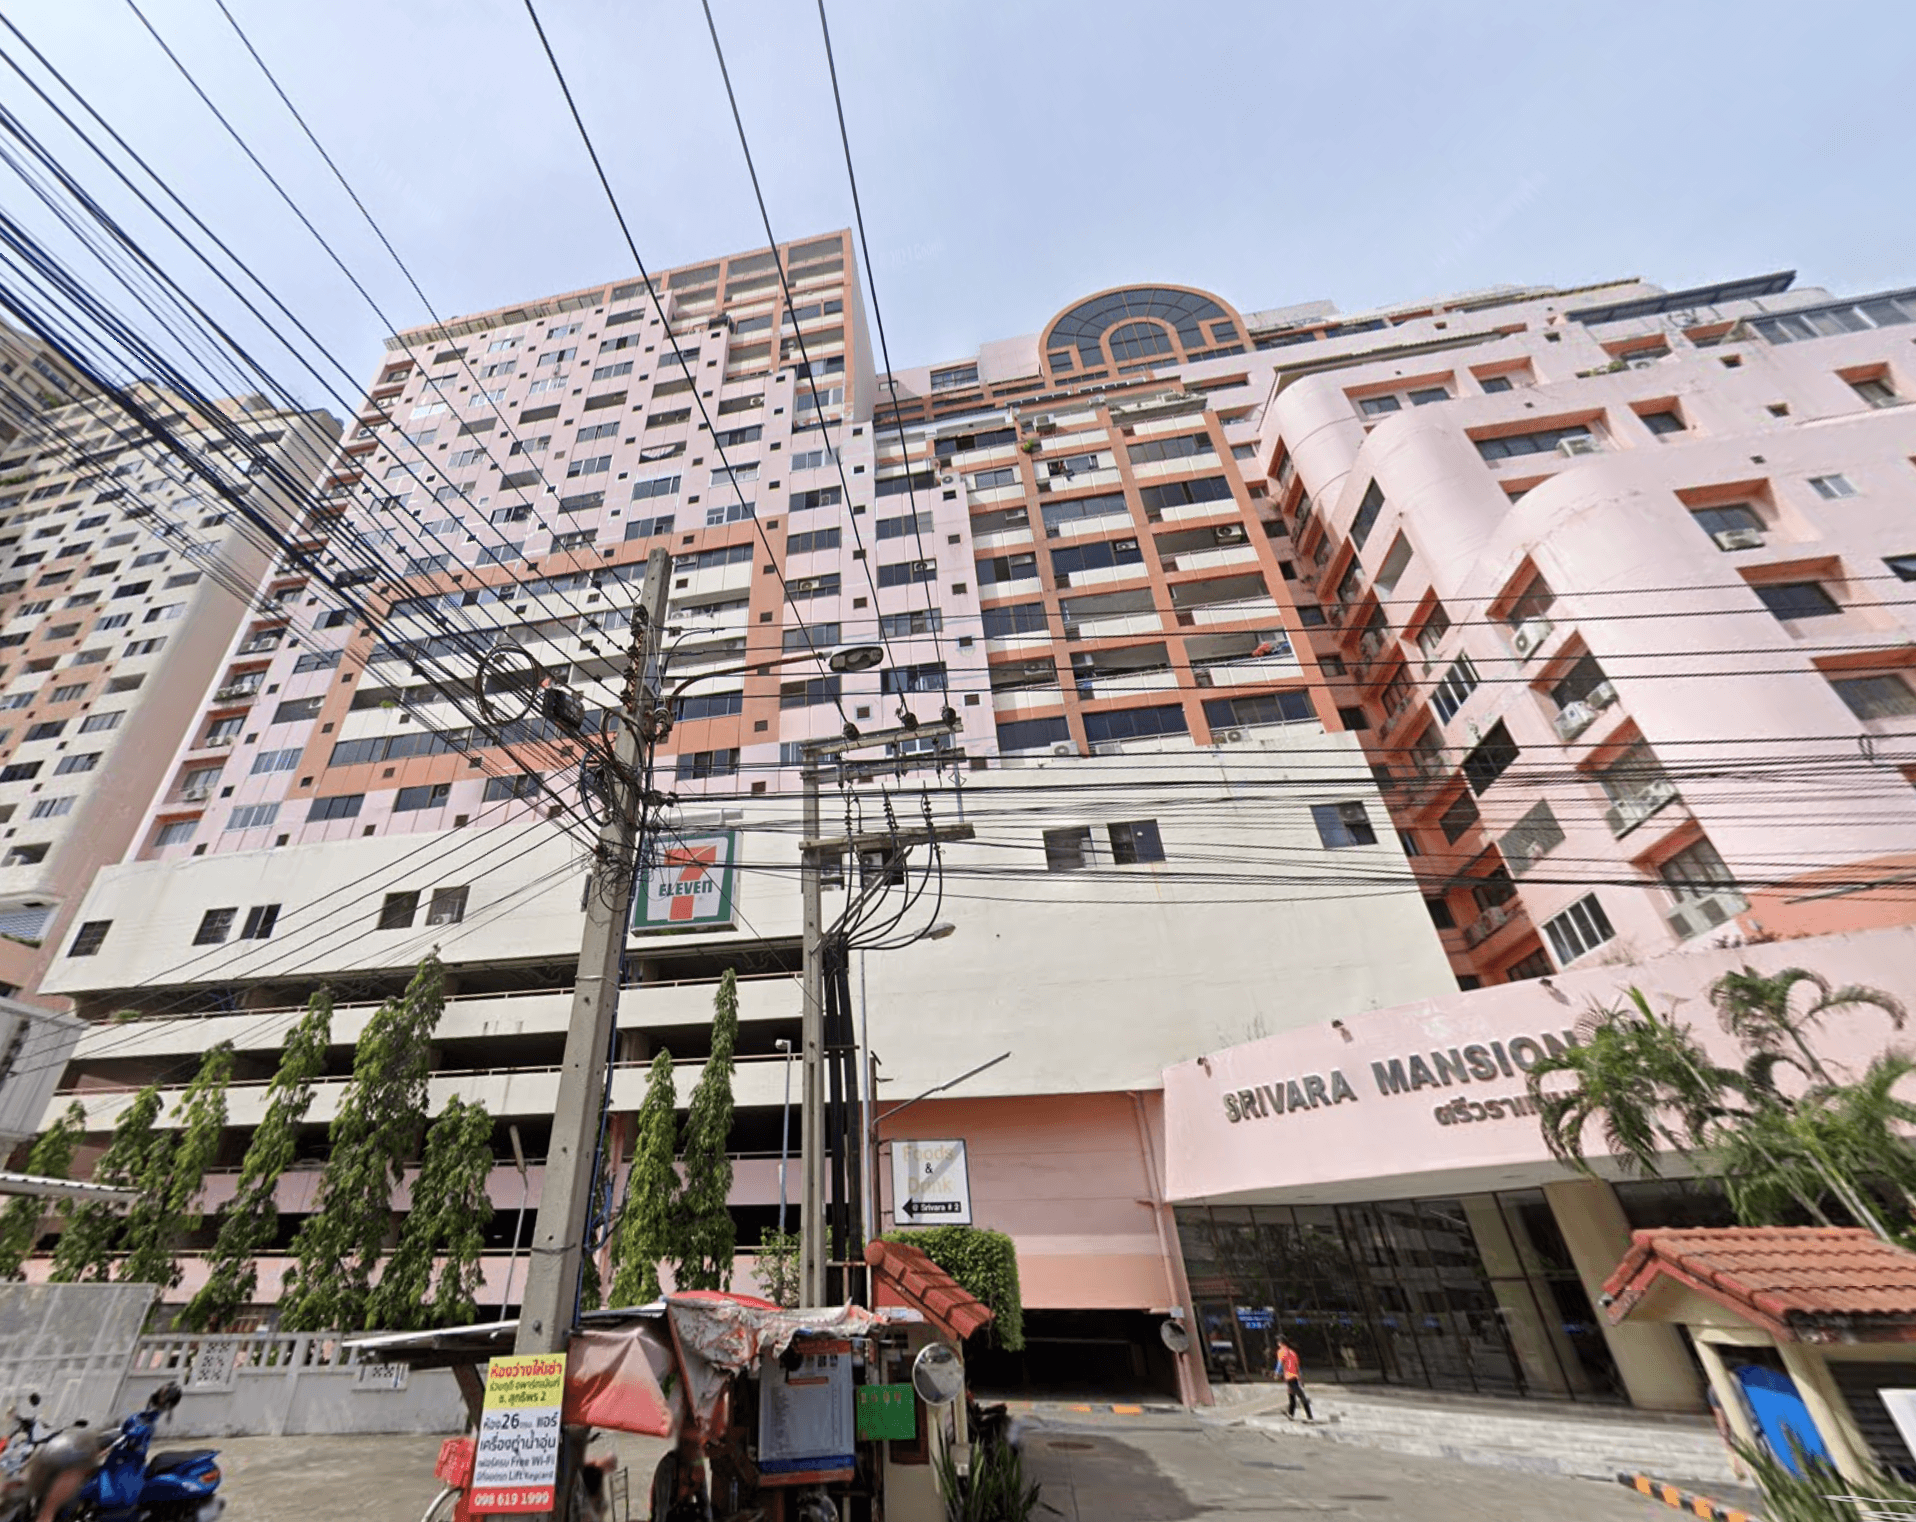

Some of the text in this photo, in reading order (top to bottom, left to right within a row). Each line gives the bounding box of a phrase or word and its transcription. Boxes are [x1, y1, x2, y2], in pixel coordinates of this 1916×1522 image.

[1223, 1070, 1359, 1124] SRIVARA
[925, 1162, 933, 1174] &
[501, 1413, 520, 1429] 26
